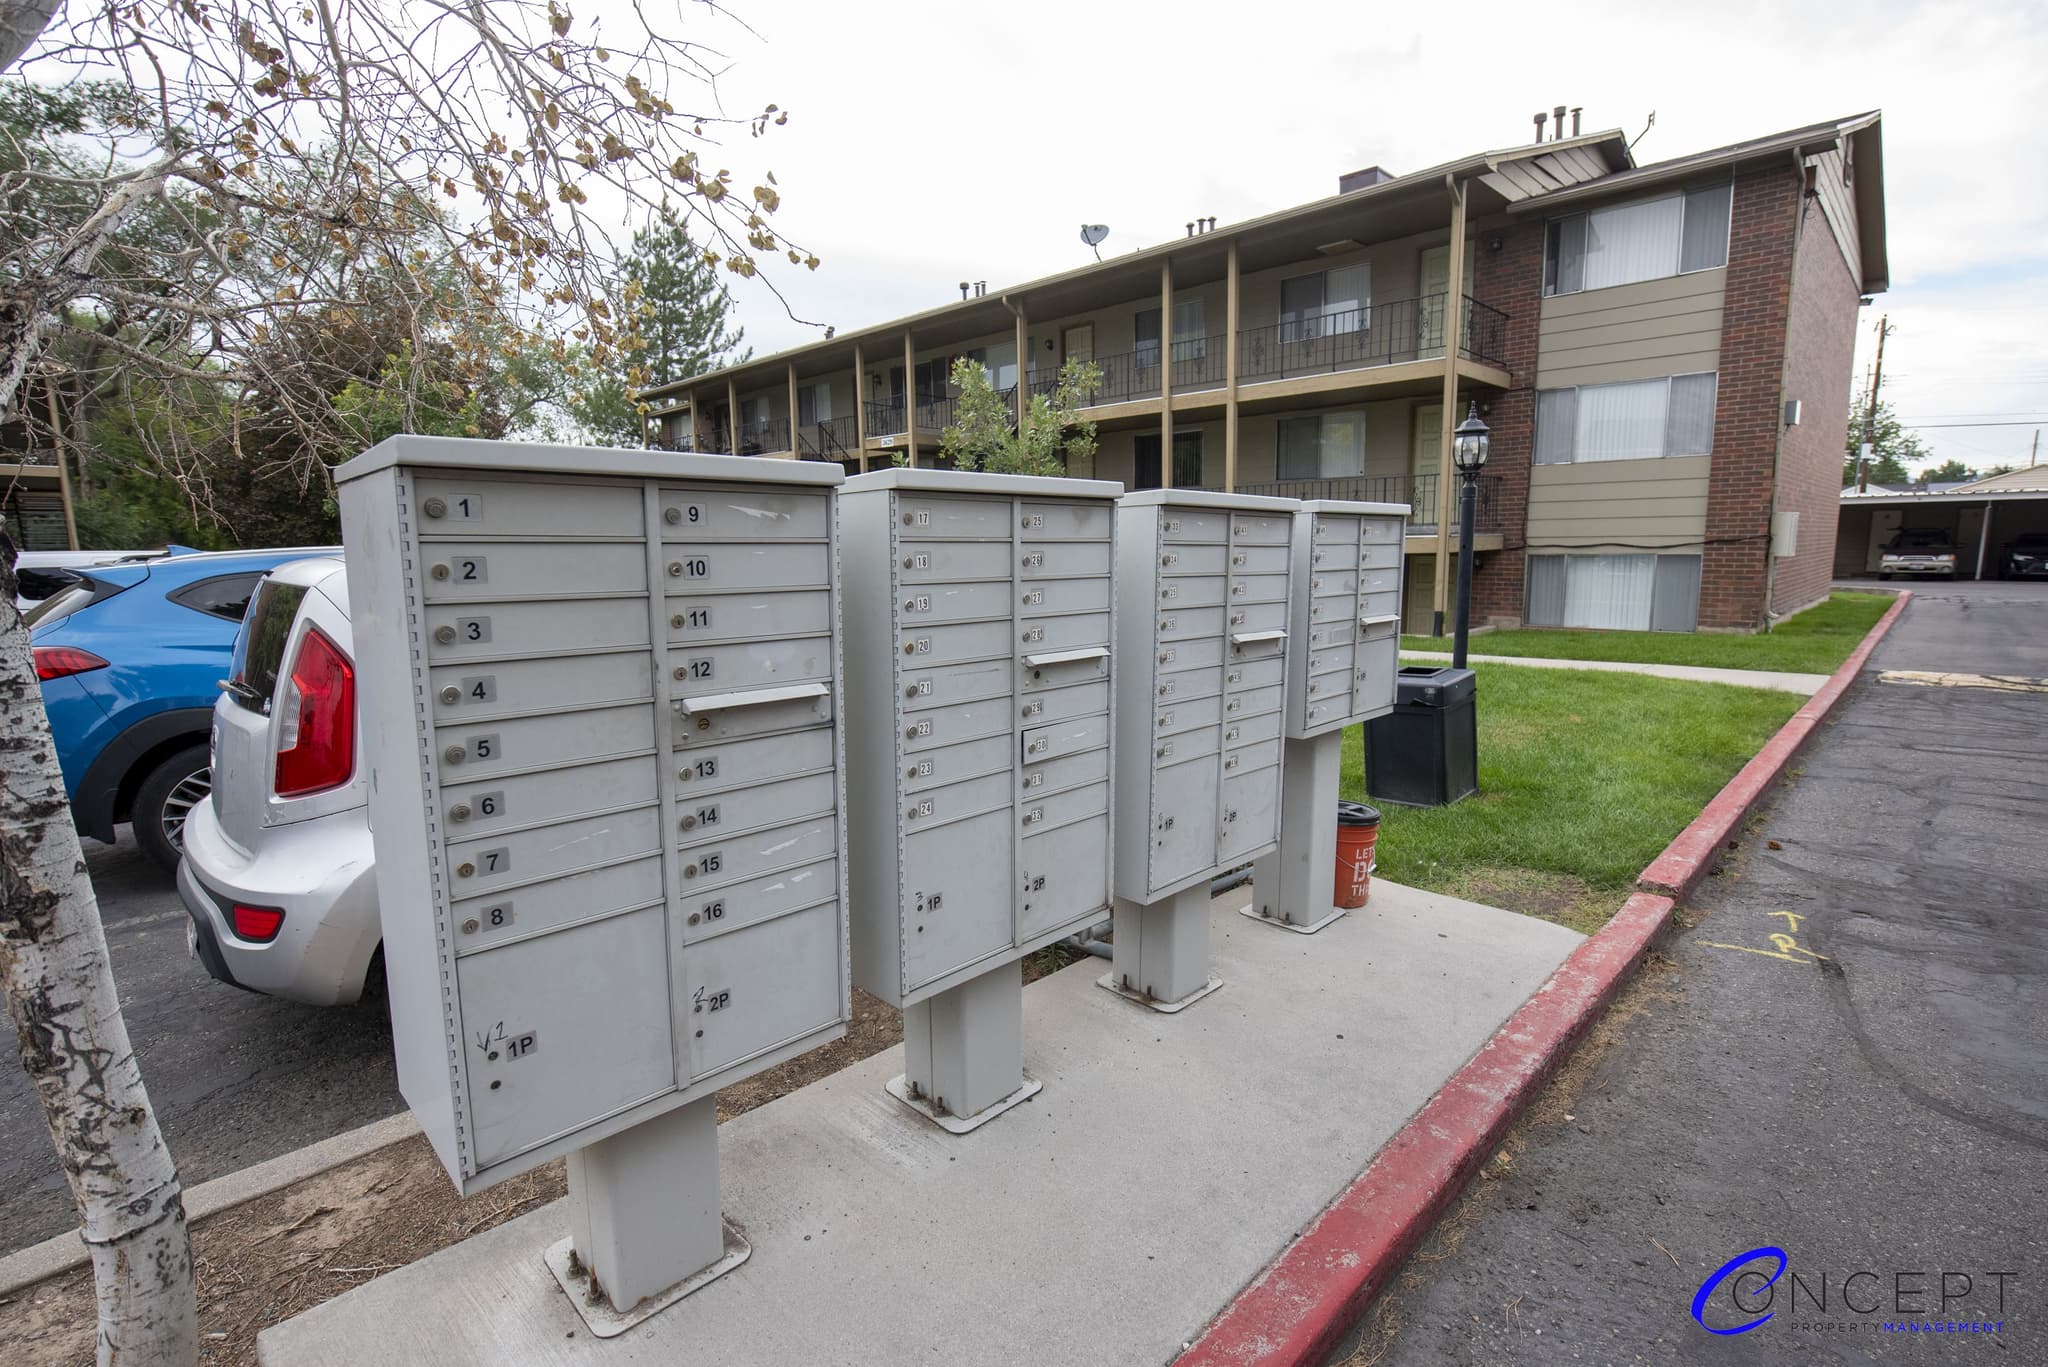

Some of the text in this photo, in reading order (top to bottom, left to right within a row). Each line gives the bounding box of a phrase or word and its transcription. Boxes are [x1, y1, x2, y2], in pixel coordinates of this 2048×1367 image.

[459, 499, 469, 517] 1
[688, 506, 699, 522] 9
[462, 562, 477, 579] 2
[686, 560, 706, 576] 10
[689, 610, 708, 627] 11
[467, 622, 481, 640] 3
[691, 661, 711, 678] 12
[472, 682, 486, 699] 4
[477, 740, 490, 757] 5
[696, 760, 715, 777] 13
[482, 797, 495, 815] 6
[698, 808, 717, 825] 14
[486, 854, 499, 871] 7
[700, 855, 720, 873] 15
[1033, 877, 1045, 892] 2P
[703, 903, 722, 920] 16
[927, 895, 941, 911] 1P
[491, 909, 504, 925] 8
[710, 992, 729, 1012] 2P
[508, 1036, 533, 1057] 1P
